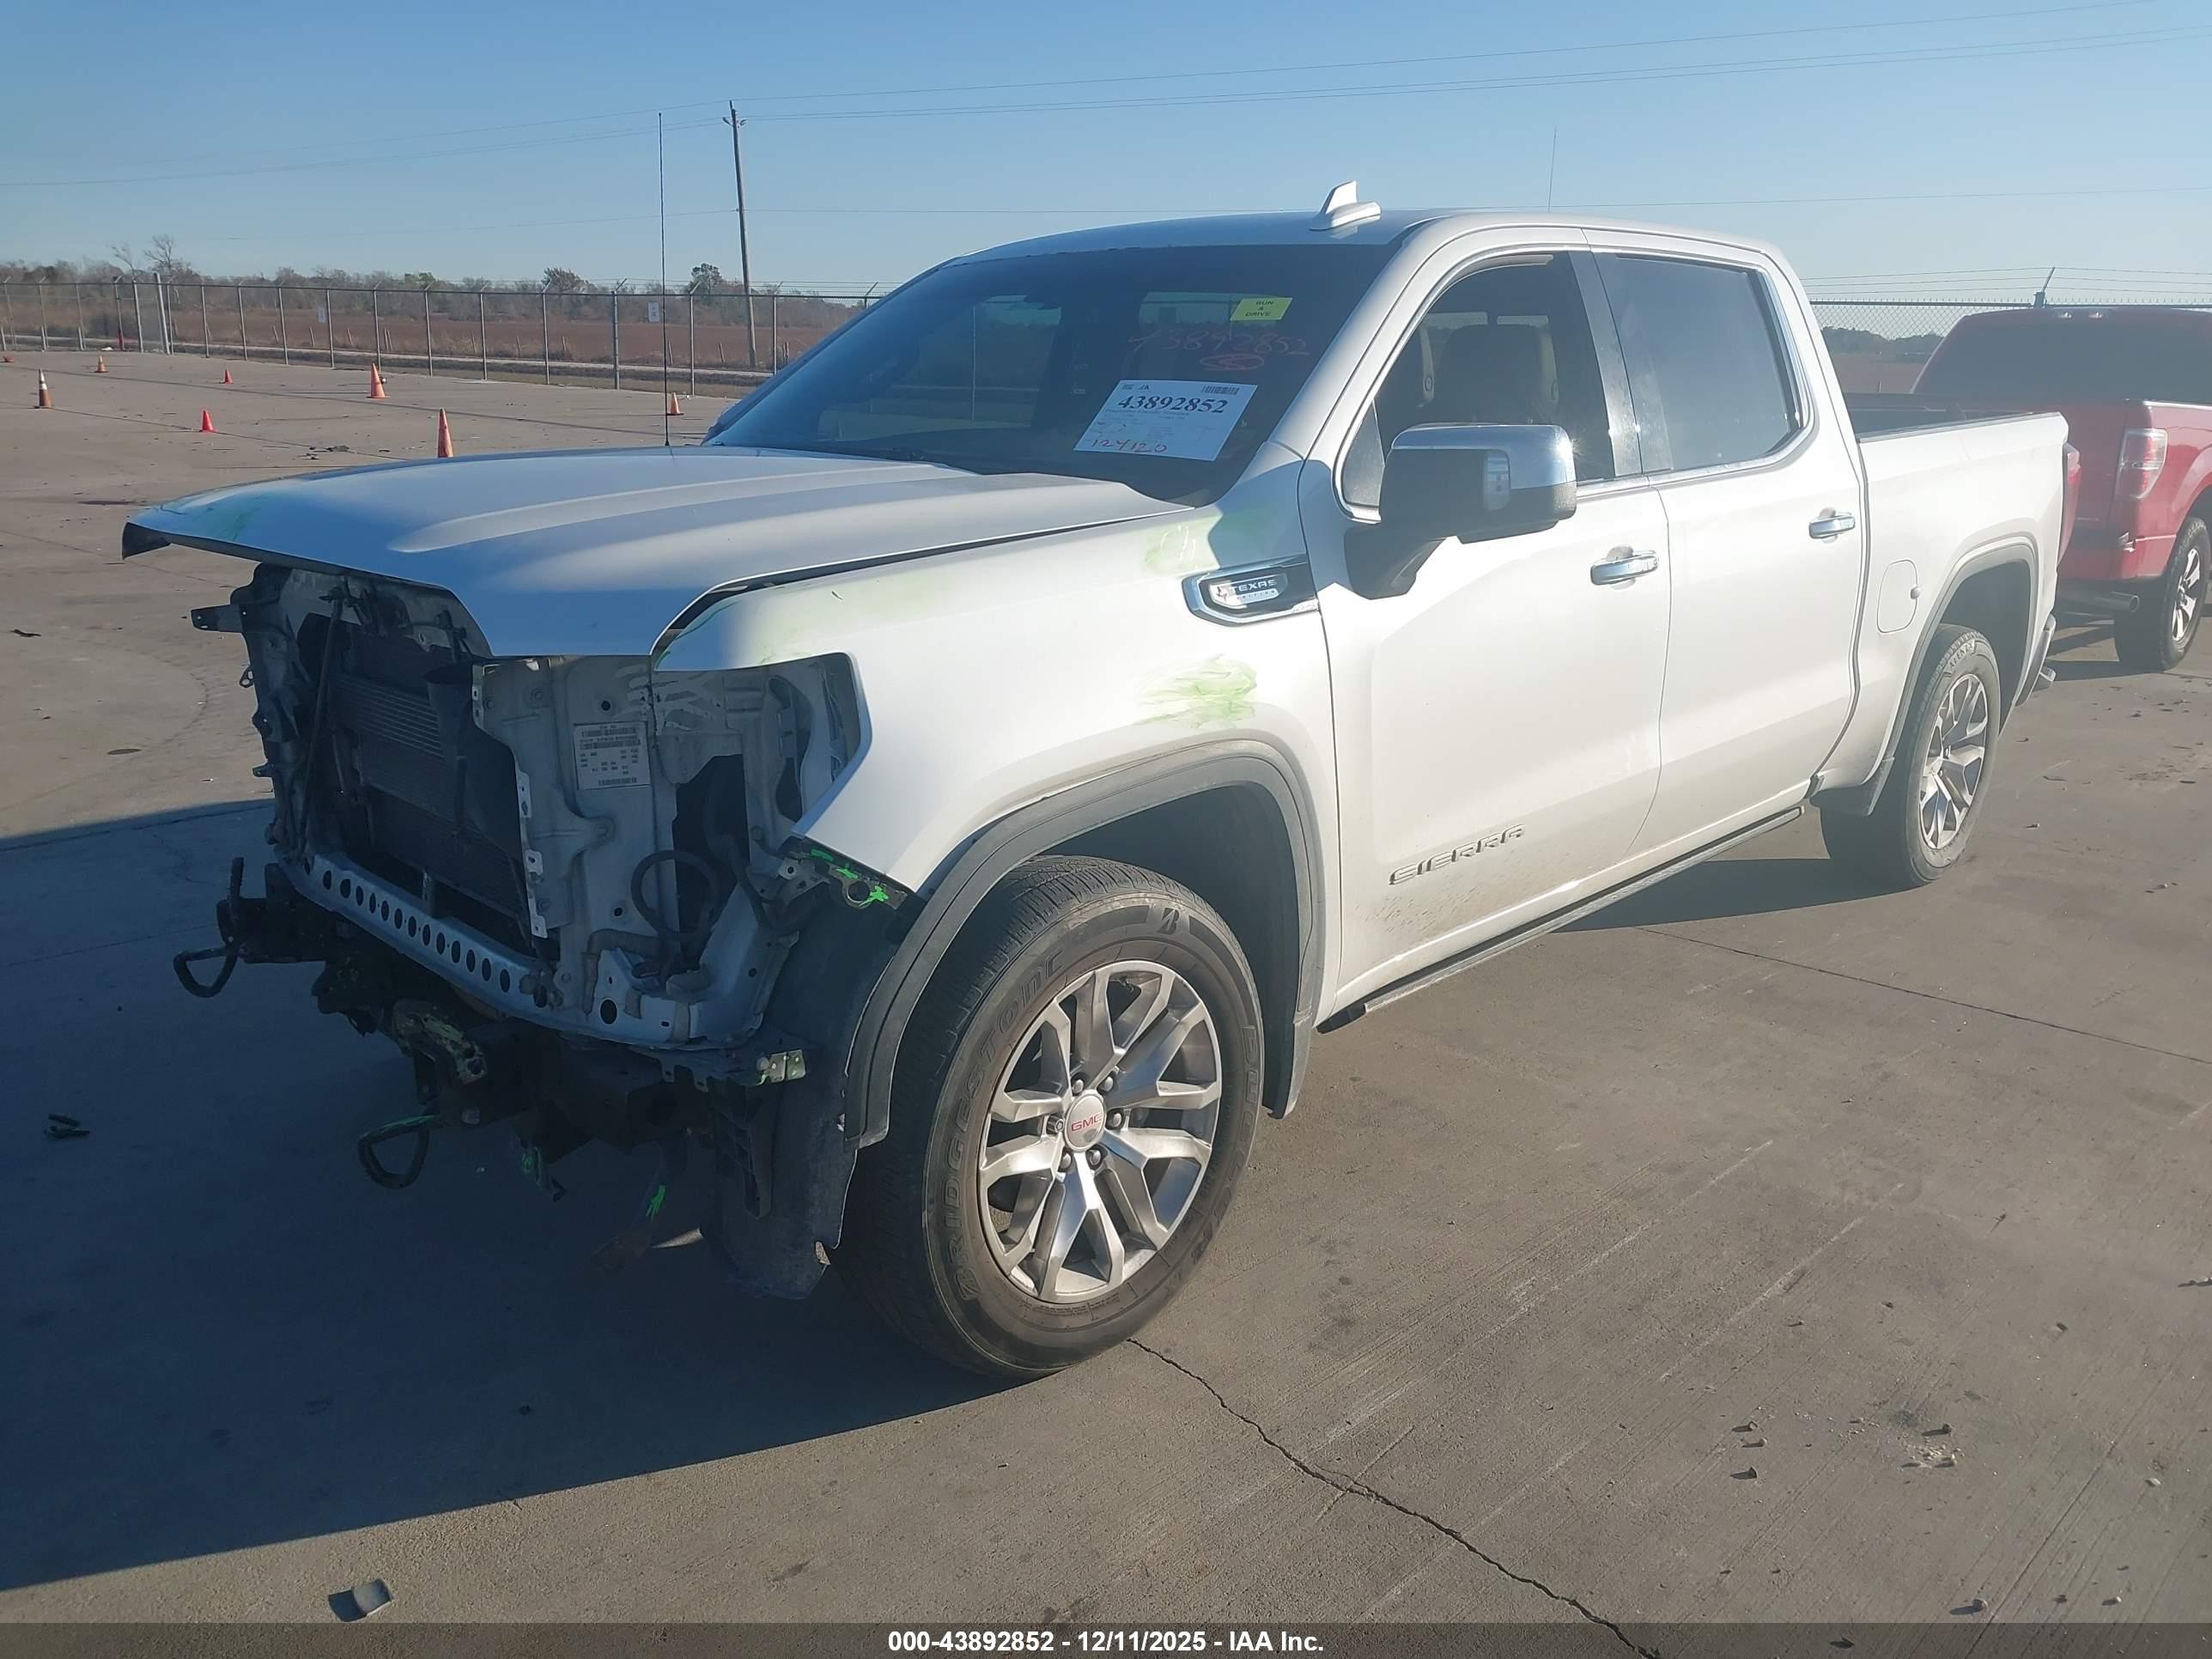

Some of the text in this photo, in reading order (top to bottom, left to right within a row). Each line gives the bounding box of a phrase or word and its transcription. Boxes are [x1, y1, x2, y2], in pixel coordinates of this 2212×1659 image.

[1117, 394, 1229, 414] 43892852
[1229, 579, 1278, 592] TEXAS
[1388, 823, 1525, 886] SIERRA
[942, 947, 1066, 1302] BRIDGESTONE
[1071, 1112, 1103, 1132] GMC
